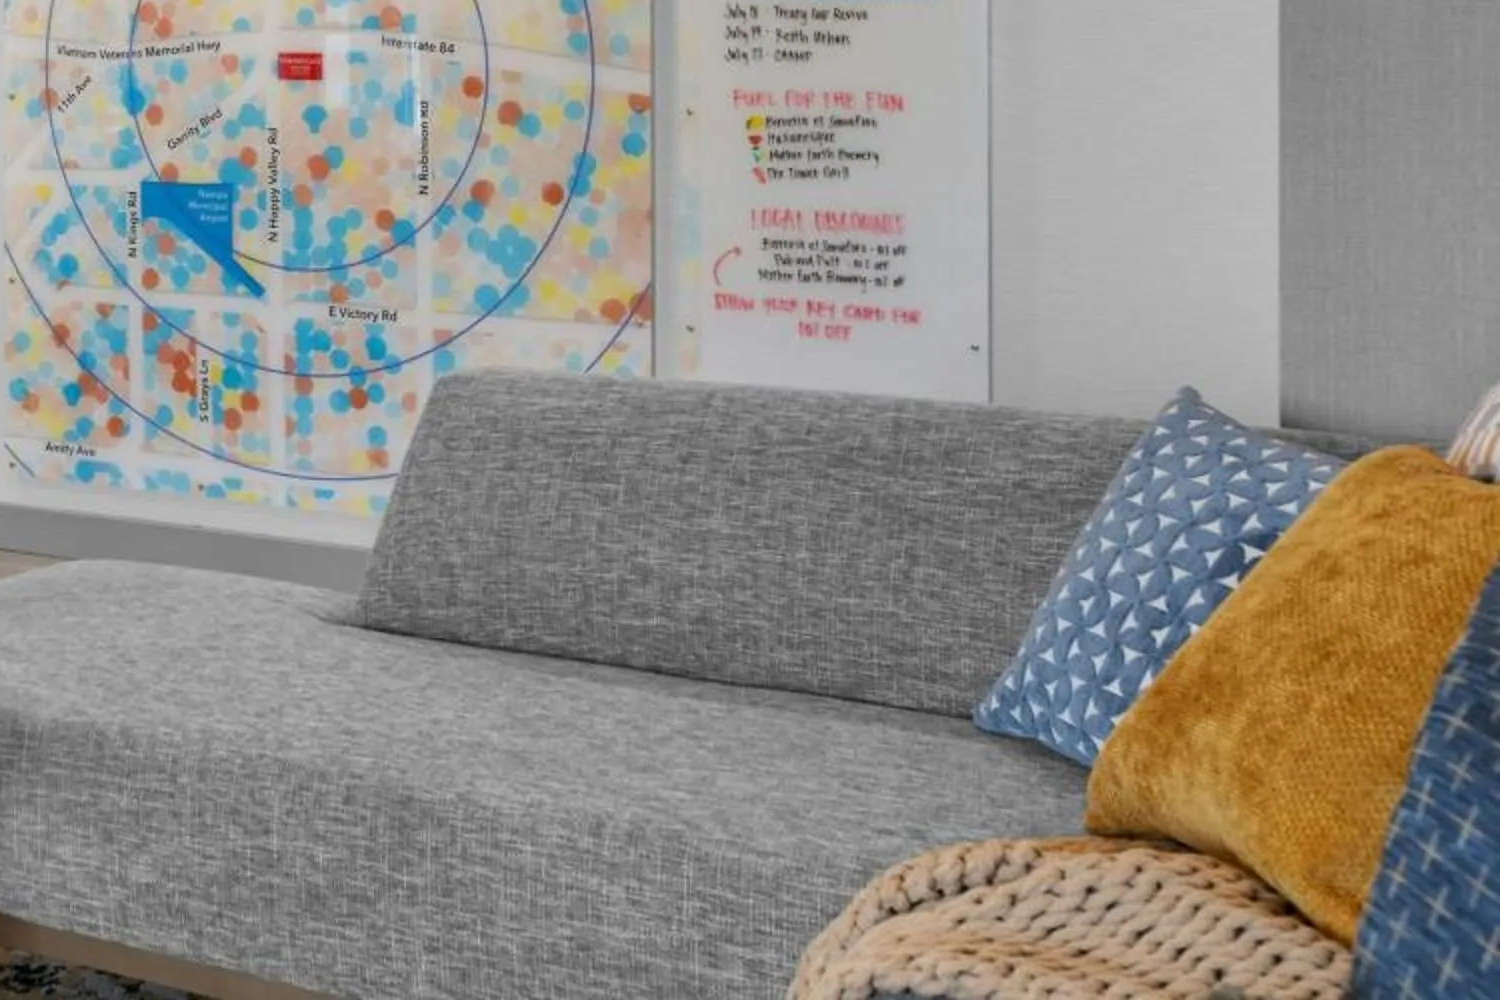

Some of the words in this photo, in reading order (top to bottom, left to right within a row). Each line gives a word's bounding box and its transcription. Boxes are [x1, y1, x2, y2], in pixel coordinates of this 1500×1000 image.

[57, 45, 97, 59] Vietnam
[100, 48, 143, 60] Veterans
[145, 41, 195, 58] Memorial
[197, 40, 221, 53] Hwy
[382, 35, 436, 52] Interstate
[439, 41, 456, 53] 84
[57, 91, 77, 112] 11th
[76, 75, 92, 96] Ave
[199, 108, 223, 128] Blvd
[420, 101, 429, 118] Rd
[268, 127, 278, 145] Rd
[419, 121, 429, 181] Robinson
[268, 147, 280, 186] Valley
[128, 191, 138, 208] Rd
[418, 185, 429, 196] N
[268, 188, 280, 230] Happy
[128, 211, 141, 245] Kings
[268, 232, 278, 243] N
[128, 248, 138, 258] N
[328, 305, 337, 317] E
[339, 306, 380, 323] Victory
[382, 309, 398, 322] Rd
[200, 360, 209, 377] Ln
[200, 414, 209, 423] S
[46, 441, 75, 456] Amity
[76, 444, 96, 456] Ave
